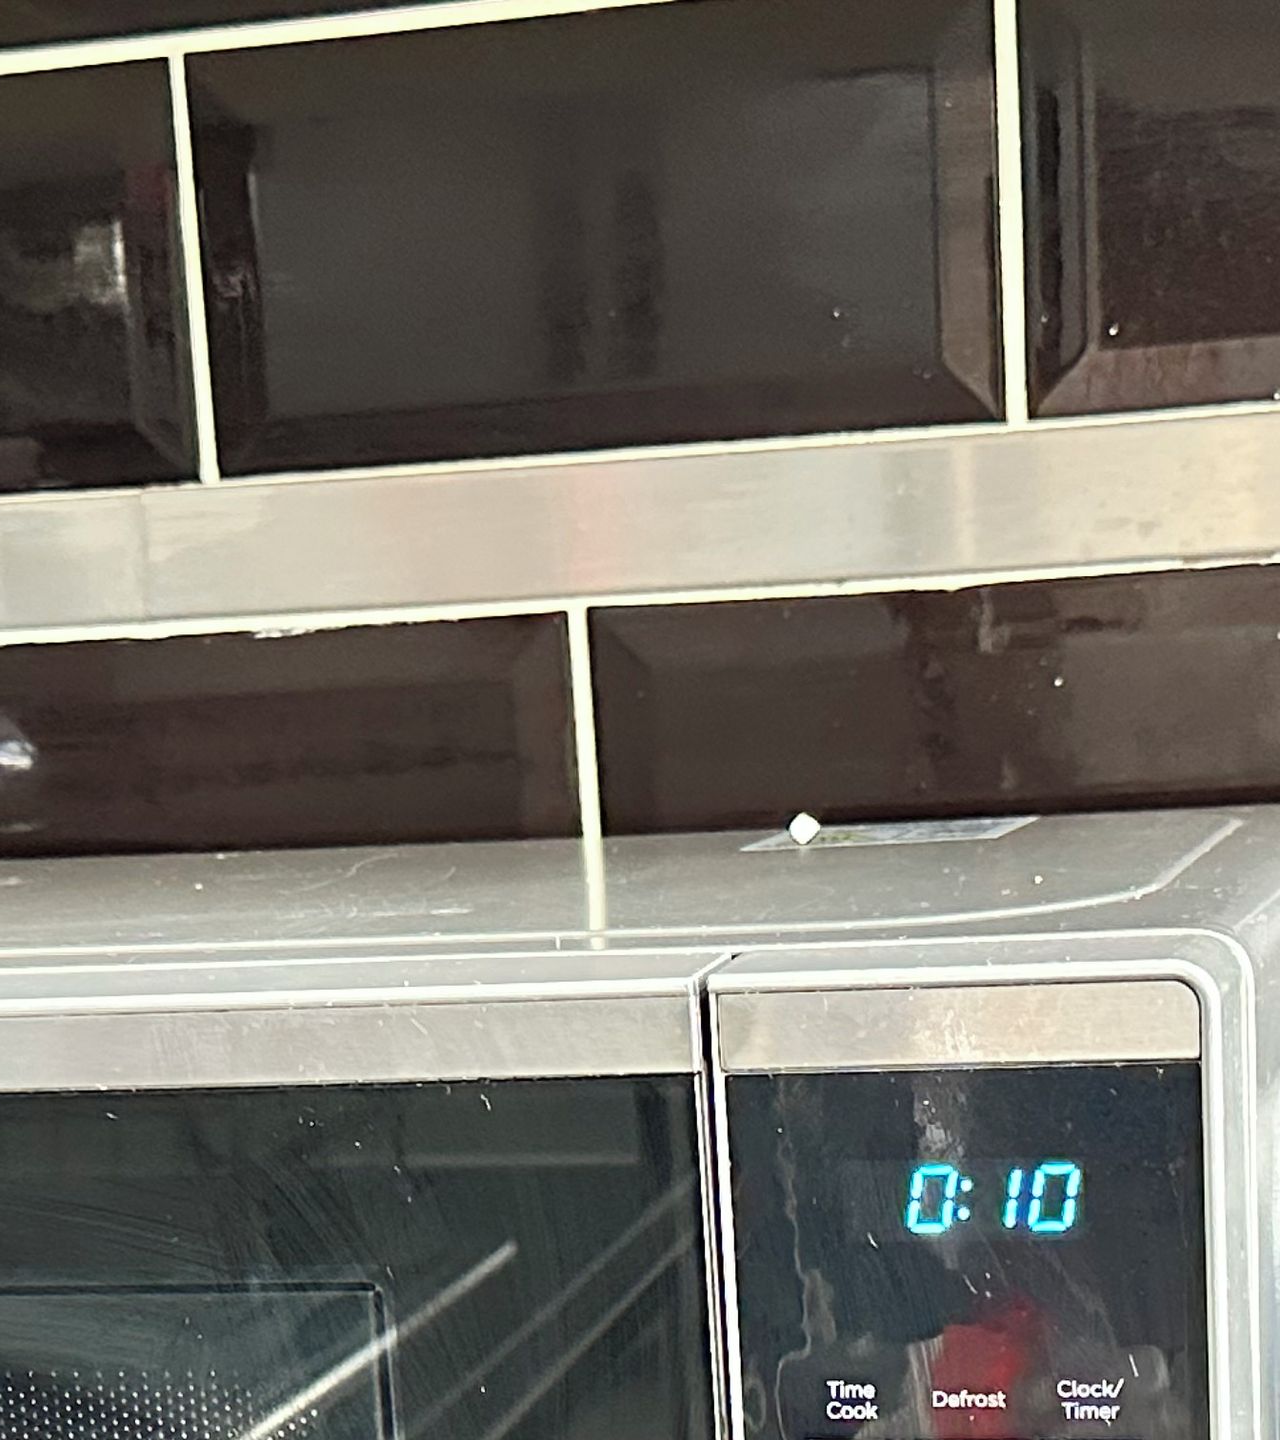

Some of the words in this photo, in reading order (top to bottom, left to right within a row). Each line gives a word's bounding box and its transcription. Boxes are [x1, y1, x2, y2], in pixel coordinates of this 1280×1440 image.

[905, 1161, 1081, 1233] 0:10
[827, 1381, 876, 1400] Time
[1057, 1379, 1124, 1398] Clock/
[932, 1391, 1006, 1408] Defrost
[827, 1402, 878, 1420] Cook
[1062, 1402, 1120, 1420] Timer
